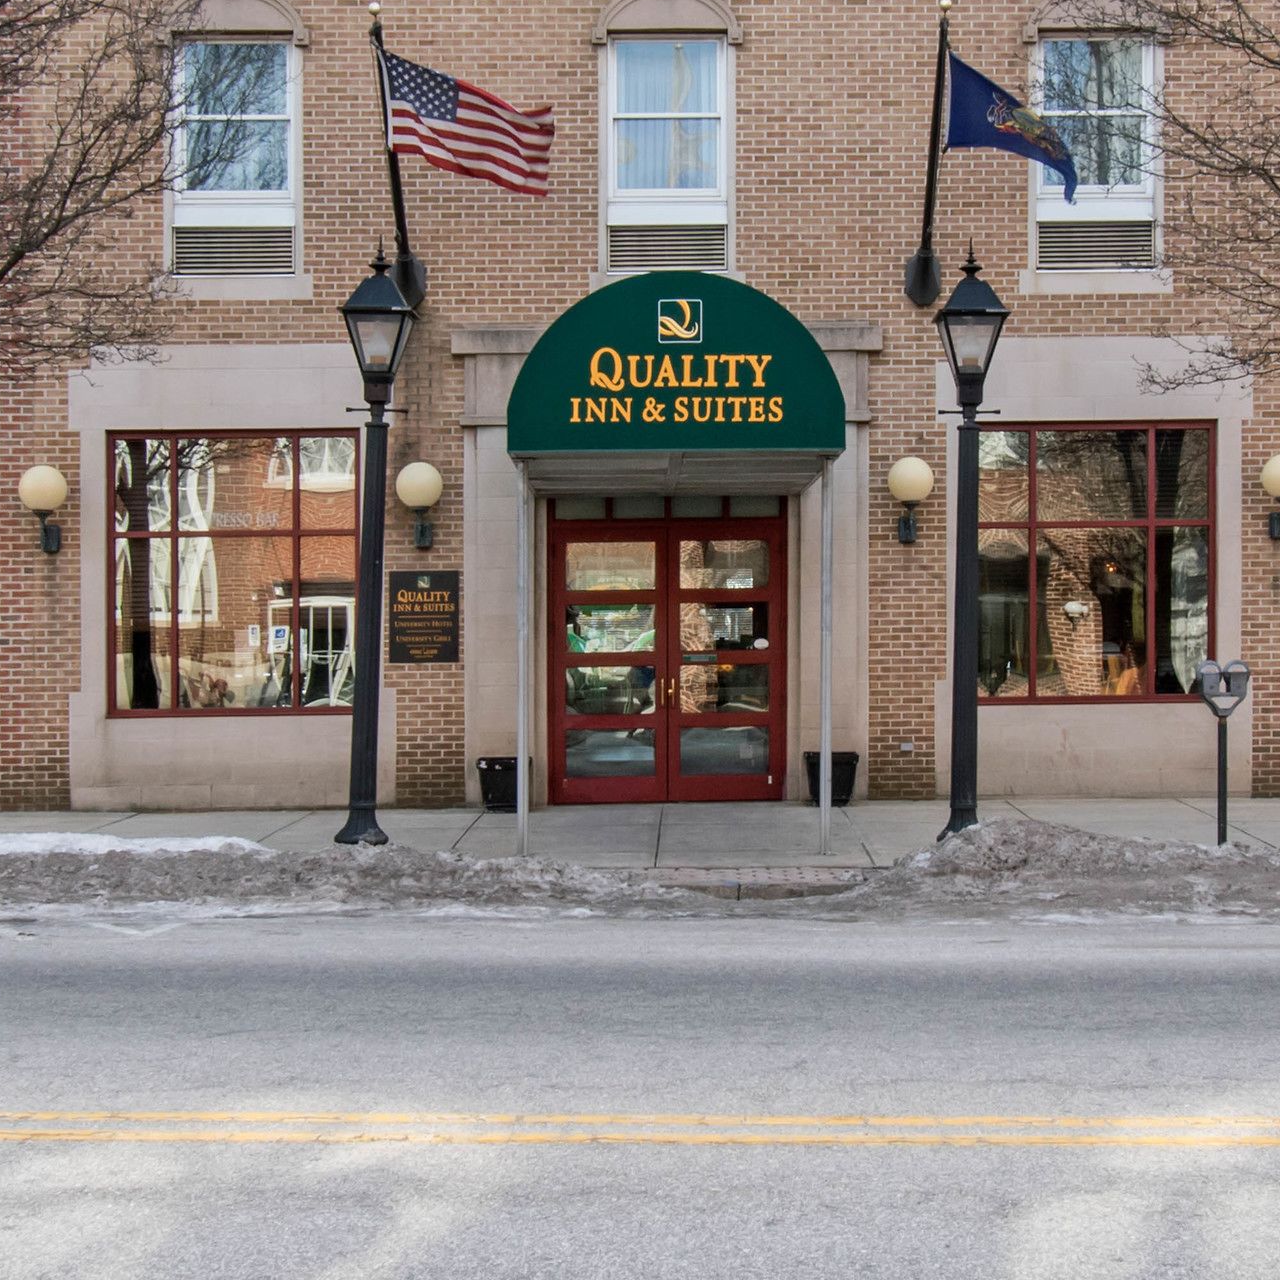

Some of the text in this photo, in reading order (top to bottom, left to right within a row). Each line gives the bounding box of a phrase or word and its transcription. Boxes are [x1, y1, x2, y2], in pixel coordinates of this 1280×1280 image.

[589, 347, 772, 392] QUALITY
[570, 396, 783, 423] INN & SUITES
[397, 589, 450, 603] QUALITY
[393, 603, 455, 612] INN & SUITES
